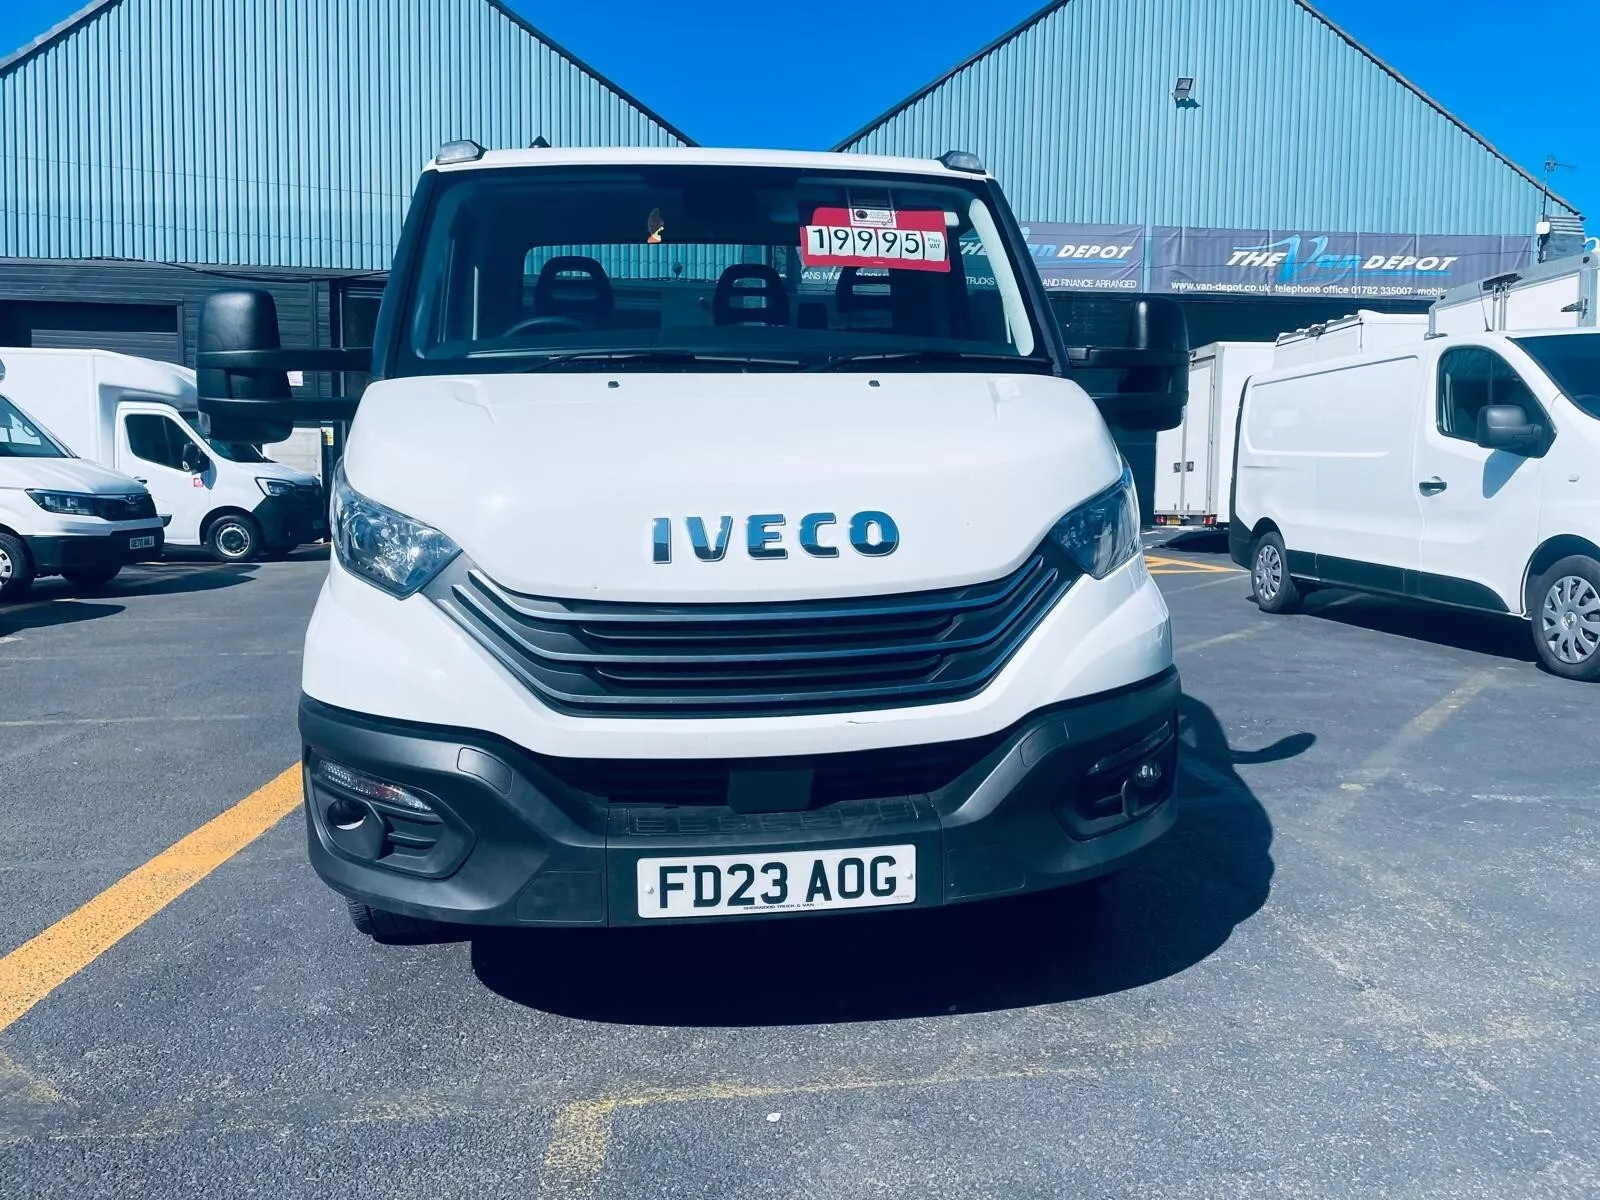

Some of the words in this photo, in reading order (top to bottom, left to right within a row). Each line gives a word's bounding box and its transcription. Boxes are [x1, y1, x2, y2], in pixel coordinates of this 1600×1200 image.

[813, 228, 920, 254] 19995
[1057, 245, 1133, 259] DEPOT
[1226, 251, 1288, 267] THE
[1272, 234, 1361, 283] Van
[1362, 255, 1459, 271] DEPOT
[965, 276, 995, 286] TRUCKS
[1043, 279, 1059, 288] AND
[1060, 279, 1093, 288] FINANCE
[1095, 280, 1137, 289] ARRANGED
[1171, 281, 1270, 293] www.van-depot.co.uk
[1275, 284, 1321, 295] telephone
[1323, 285, 1349, 294] office
[1351, 286, 1378, 295] 01782
[1380, 286, 1413, 296] 335007
[652, 511, 900, 564] IVECO
[659, 862, 788, 909] FD23
[806, 855, 897, 902] AOG
